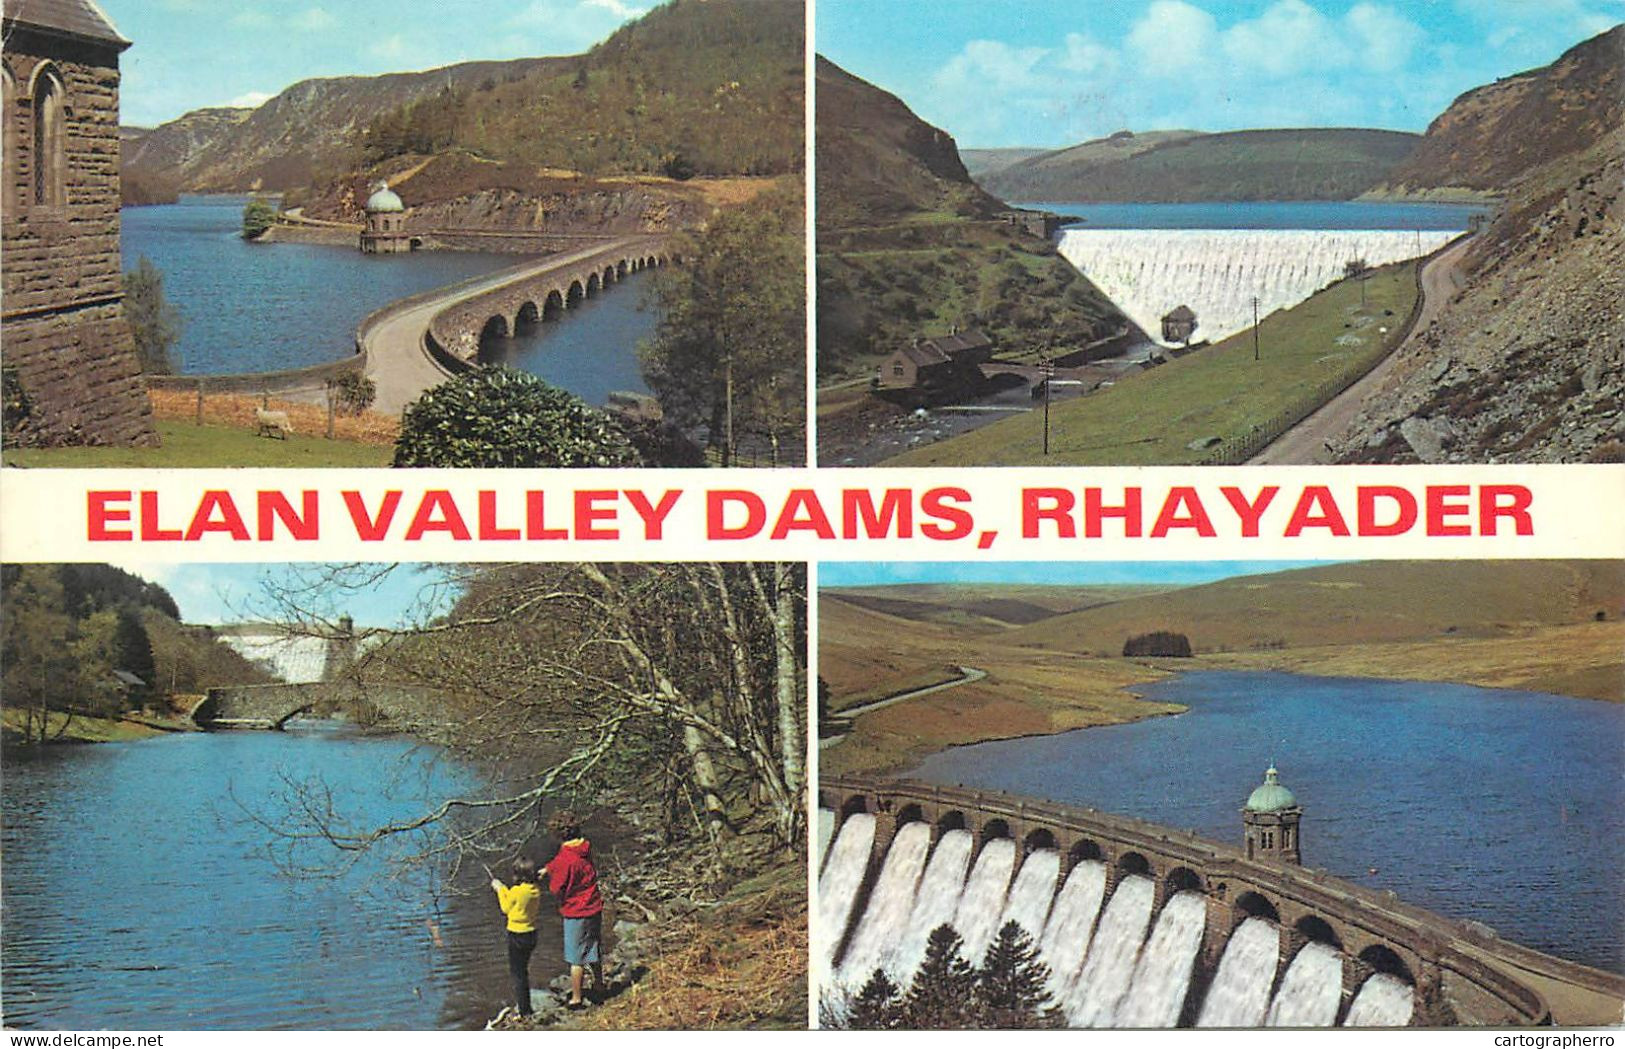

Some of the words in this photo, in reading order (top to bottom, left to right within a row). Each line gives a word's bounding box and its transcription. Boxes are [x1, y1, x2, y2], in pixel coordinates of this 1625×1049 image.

[86, 489, 320, 542] ELAN
[340, 489, 684, 541] VALLEY
[706, 486, 998, 550] DAMS,
[1021, 484, 1535, 540] RHAYADER
